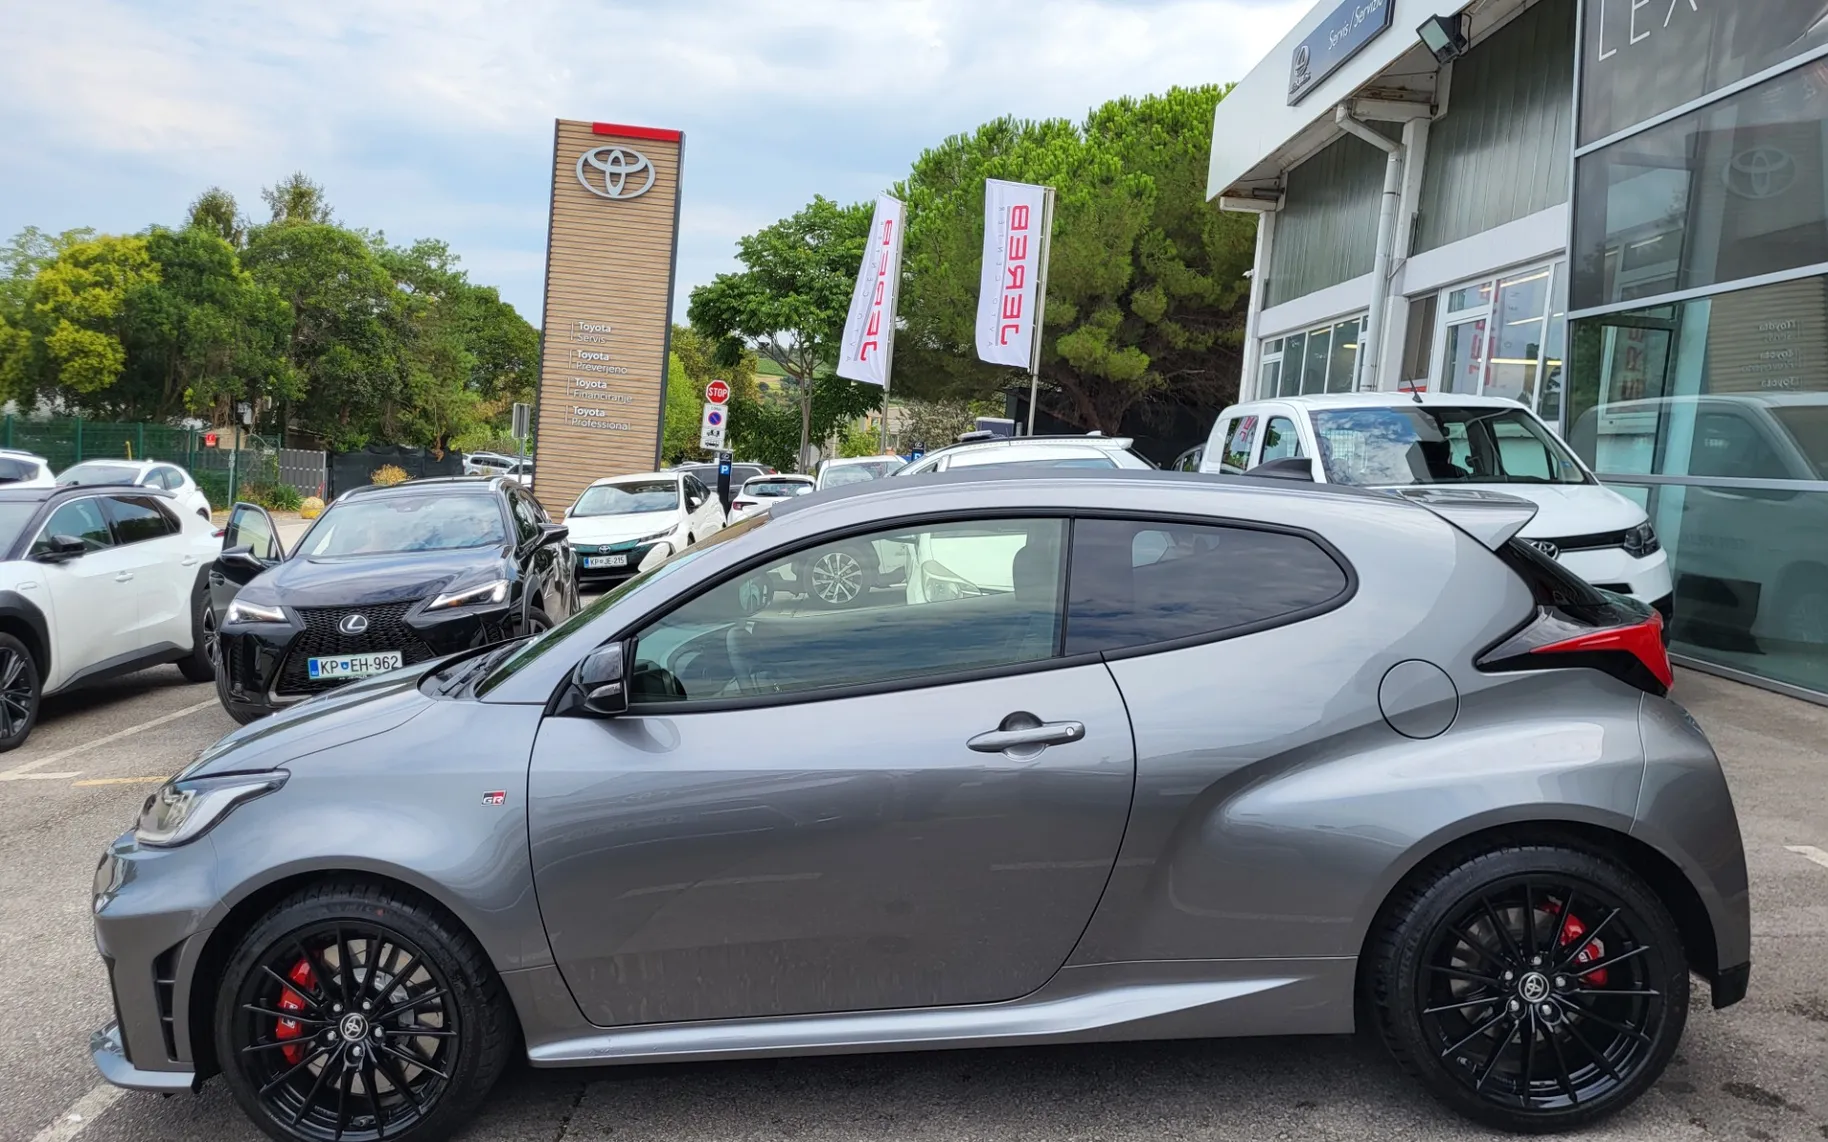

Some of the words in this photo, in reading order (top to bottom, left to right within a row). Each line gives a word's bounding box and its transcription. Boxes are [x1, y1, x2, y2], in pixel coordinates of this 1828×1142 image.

[578, 321, 611, 333] Toyota
[577, 334, 606, 344] Servis
[576, 350, 609, 361] Toyota
[574, 377, 608, 389] Toyota
[708, 387, 728, 398] STOP
[572, 405, 606, 417] Toyota
[571, 418, 631, 431] Professional
[321, 660, 339, 675] KP
[350, 655, 399, 672] EH-962
